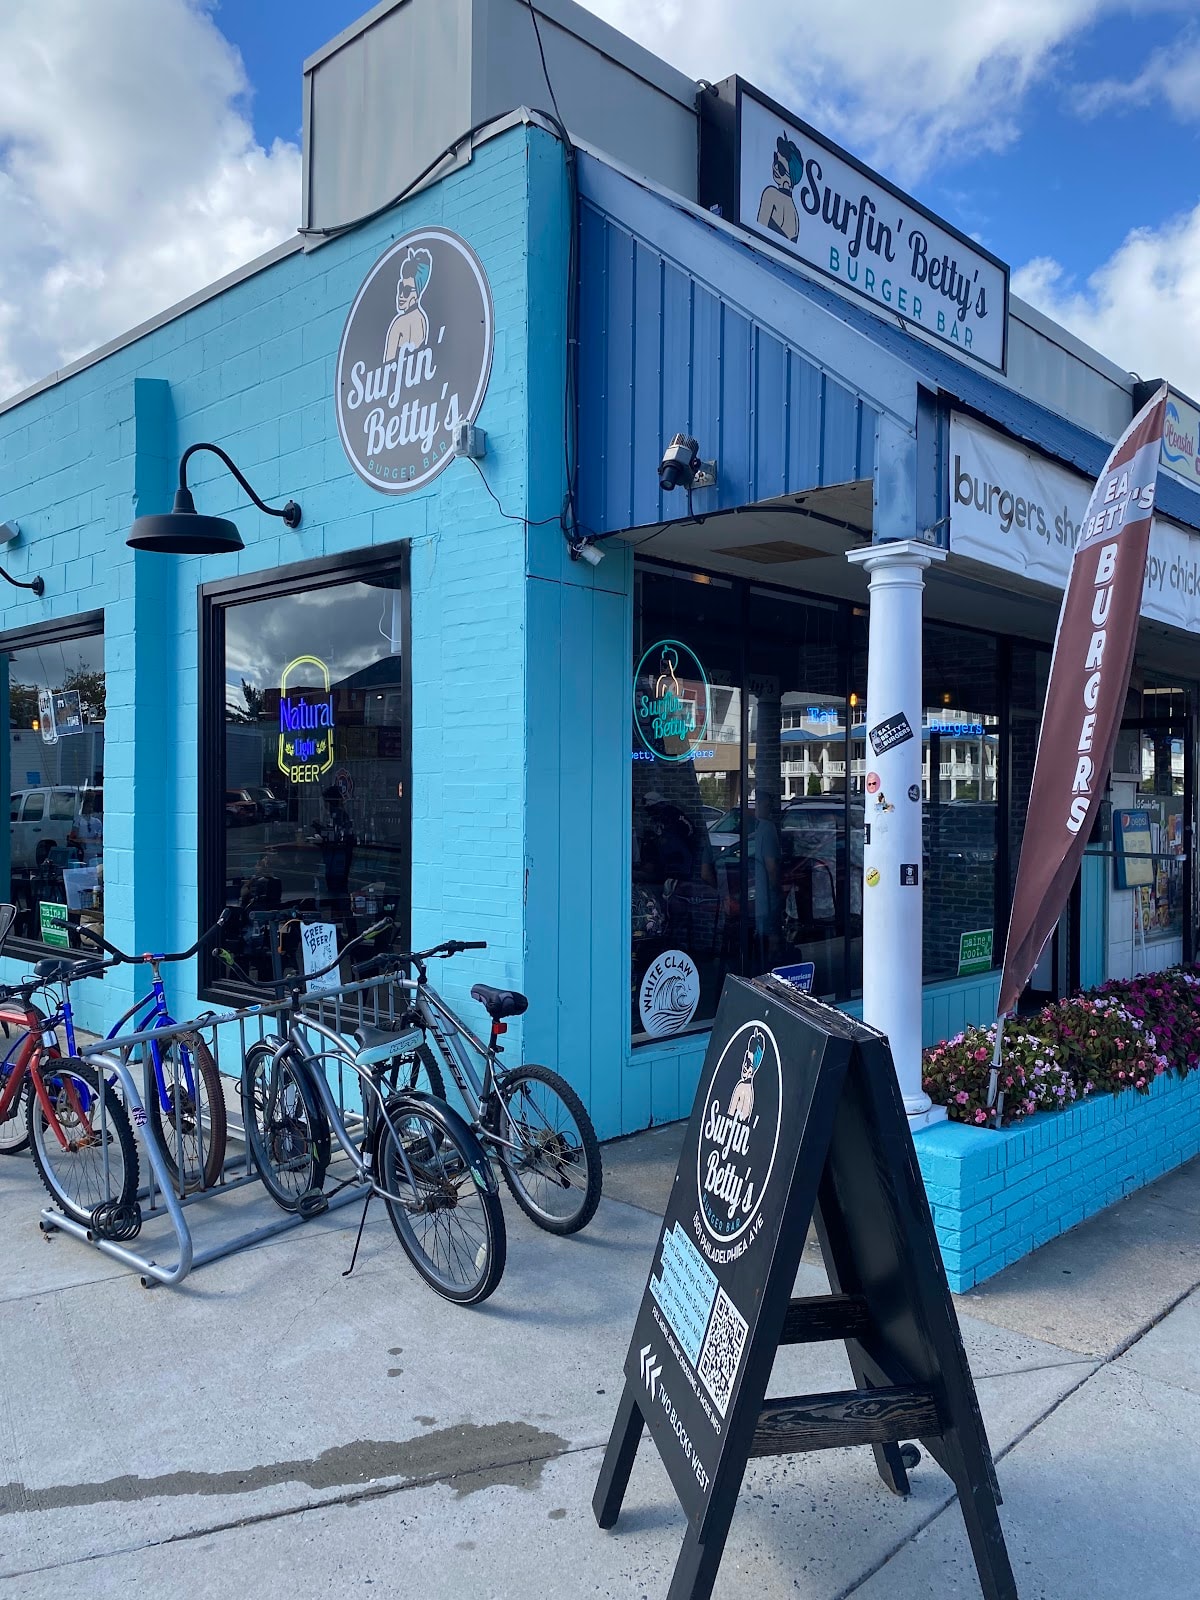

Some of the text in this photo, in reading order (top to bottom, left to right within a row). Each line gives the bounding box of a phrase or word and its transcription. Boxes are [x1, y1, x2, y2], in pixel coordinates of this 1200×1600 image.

[800, 159, 988, 322] Surfin' Betty's
[830, 246, 973, 349] BURGER BAR
[347, 326, 445, 410] Surfin'
[364, 382, 464, 456] Betty's
[368, 441, 447, 479] BURGER BAR
[954, 455, 1051, 546] burgers,
[1066, 543, 1118, 836] BURGERS
[280, 694, 335, 733] Natural
[652, 711, 696, 740] Betty's
[806, 706, 838, 724] Eat
[878, 724, 890, 736] EAT
[880, 722, 907, 741] BETTY'S
[294, 738, 315, 762] Light
[882, 727, 911, 746] BURGERS
[290, 764, 320, 783] BEER
[304, 925, 323, 946] FREE
[309, 930, 333, 955] BEER!
[643, 955, 693, 1013] WHITE CLAW
[705, 1099, 759, 1160] Surfin'
[704, 1150, 754, 1219] Betty's
[702, 1193, 741, 1232] BURGER BAR
[749, 1212, 764, 1245] AVE
[698, 1260, 717, 1292] Burgers
[658, 1382, 710, 1494] TWO BLOCKS WEST
